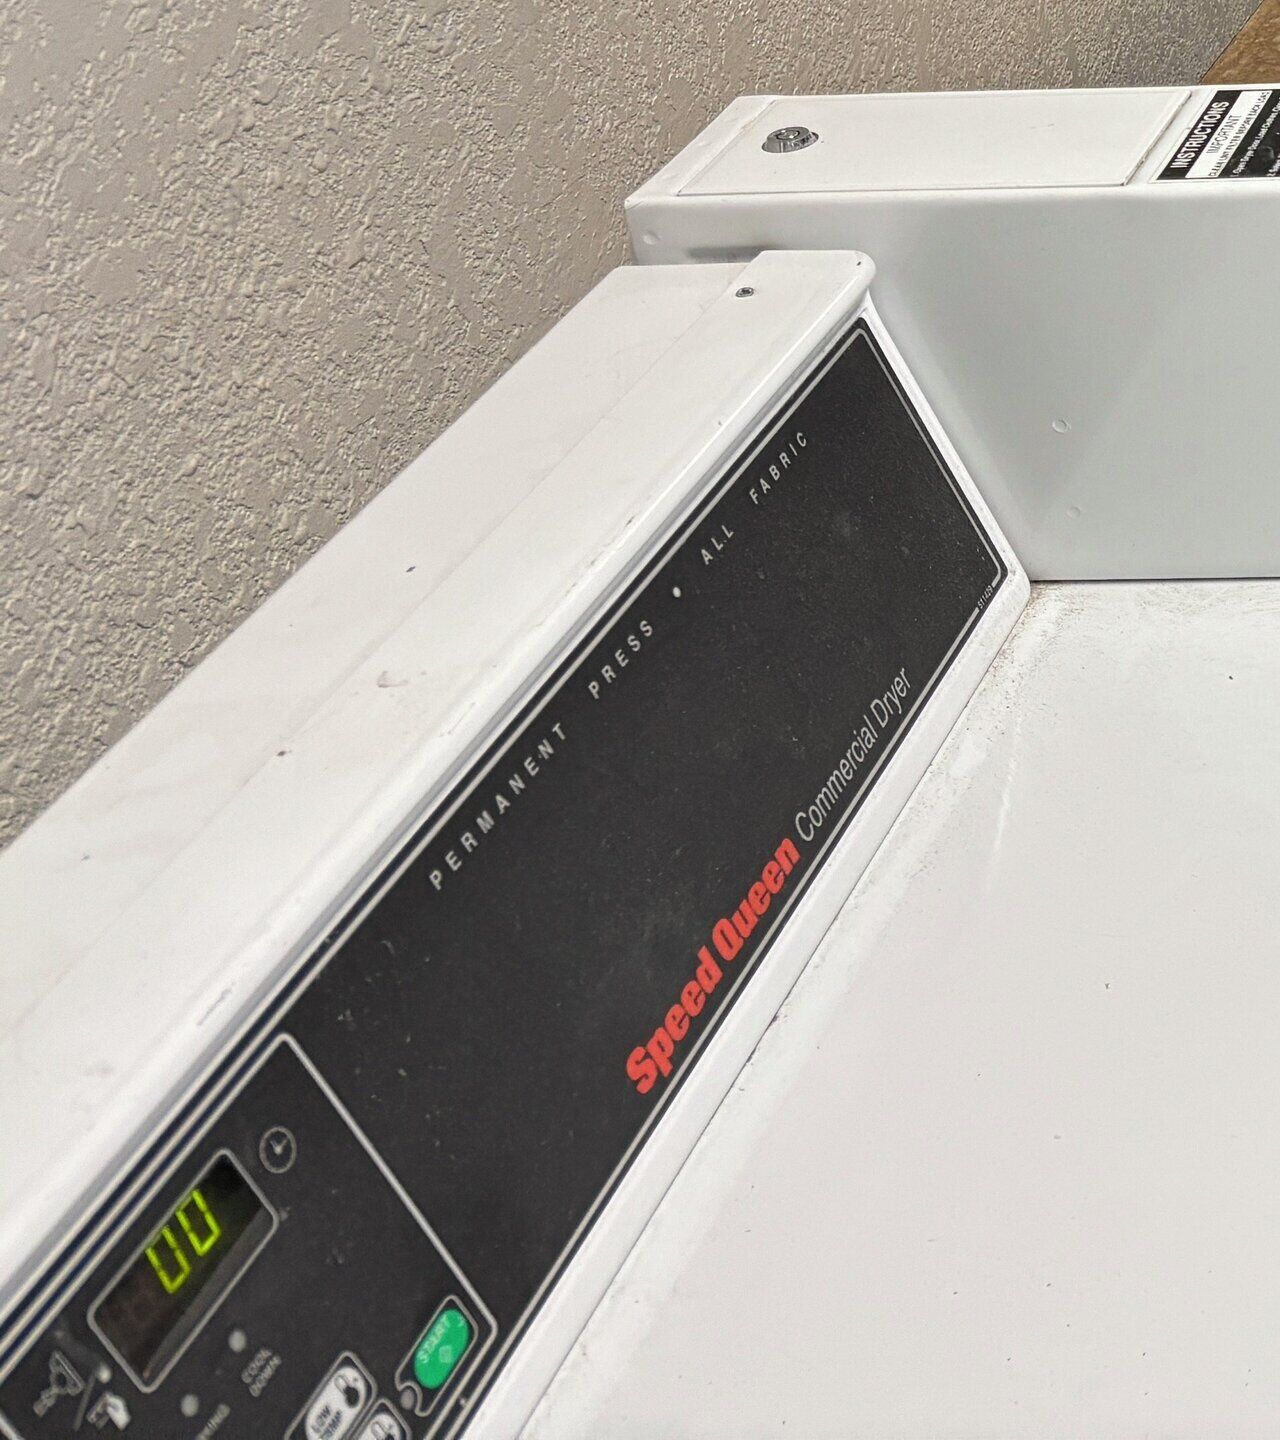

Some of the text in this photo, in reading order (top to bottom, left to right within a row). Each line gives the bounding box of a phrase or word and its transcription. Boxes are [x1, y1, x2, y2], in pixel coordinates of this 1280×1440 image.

[1169, 101, 1231, 168] INSTRUCTIONS
[1204, 115, 1243, 154] IMPORTANT
[429, 431, 808, 891] PERMANENT PRESS ALL FABRIC
[625, 667, 912, 1095] Speed Queen Commercial Dryer
[145, 1189, 221, 1294] 00
[417, 1314, 450, 1364] START
